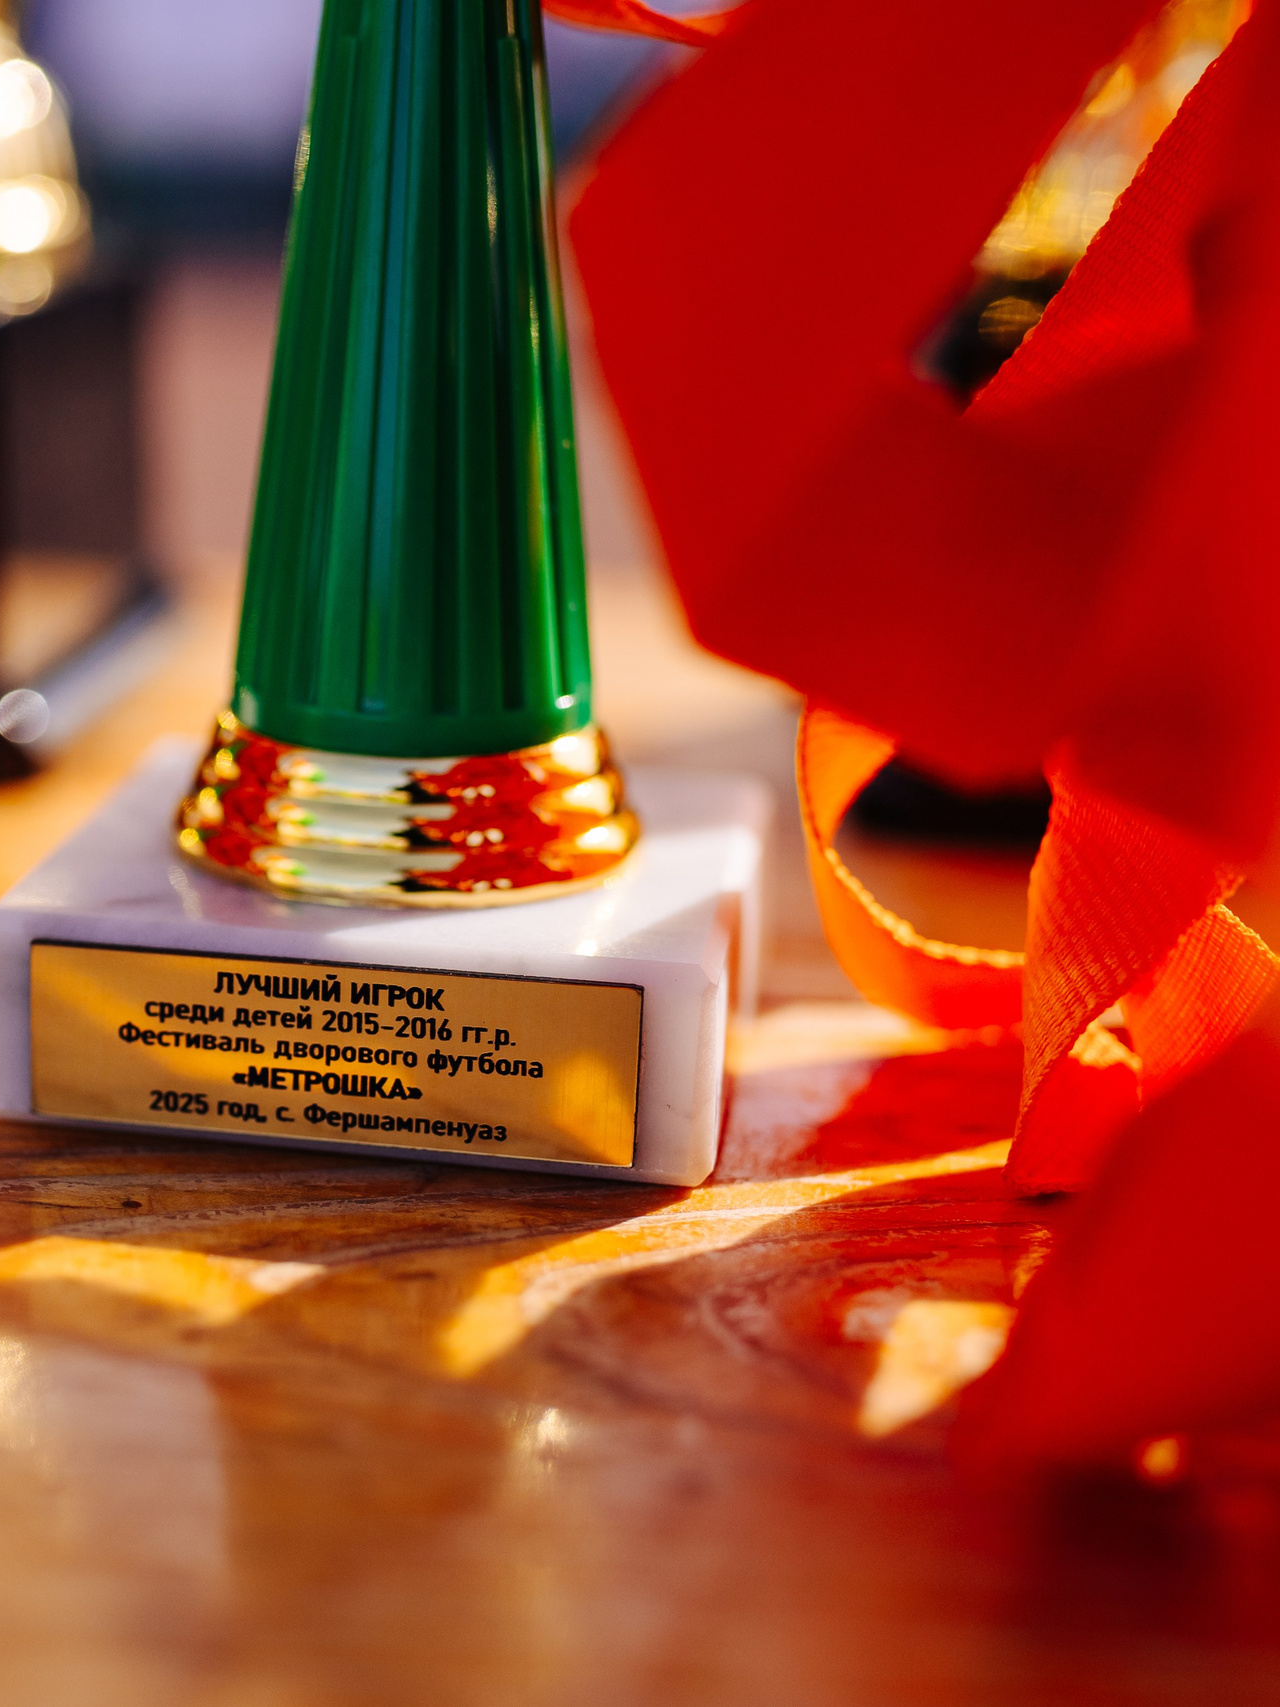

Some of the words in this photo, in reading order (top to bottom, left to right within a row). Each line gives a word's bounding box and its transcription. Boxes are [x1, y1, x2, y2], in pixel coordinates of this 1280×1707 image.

[213, 971, 341, 1004] ЛУЧШИЙ
[350, 982, 445, 1011] ИГРОК
[118, 1021, 265, 1054] Фестиваль
[273, 1040, 418, 1069] дворового
[427, 1049, 544, 1078] футбола
[145, 1001, 224, 1024] среди
[232, 1006, 312, 1029] детей
[461, 1025, 517, 1050] гг.р.
[232, 1066, 423, 1100] «МЕТРОШКА»
[149, 1090, 210, 1115] 2025
[275, 1106, 295, 1122] с.
[303, 1104, 508, 1144] Фершампенуаз
